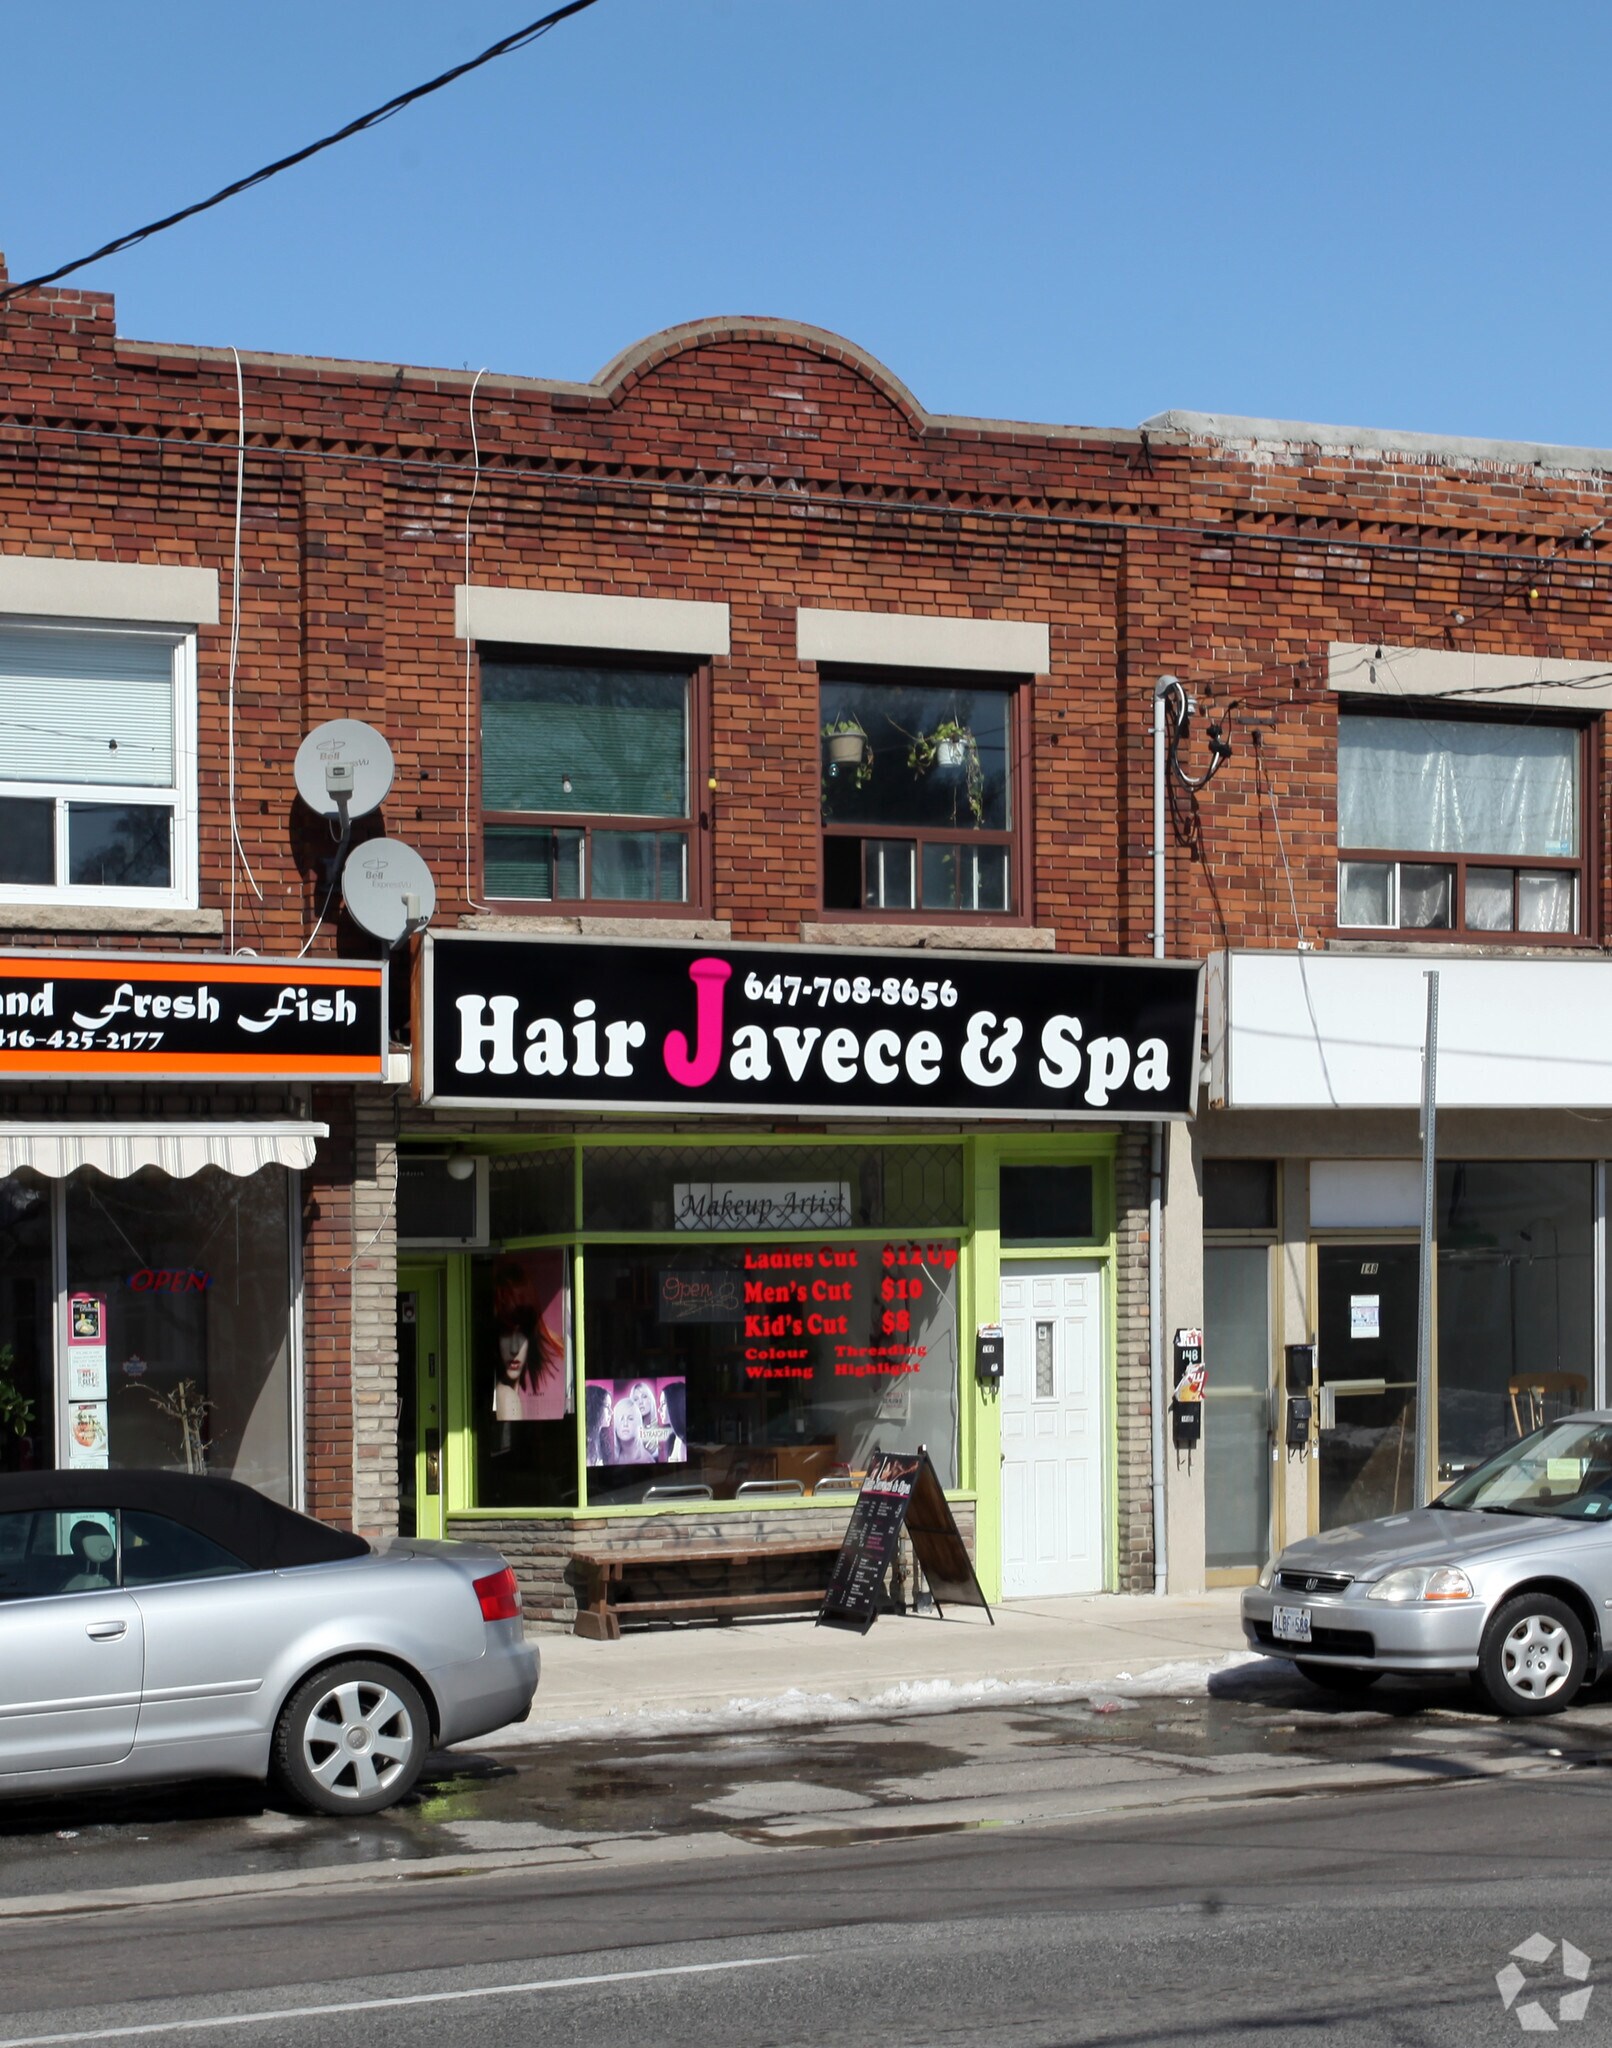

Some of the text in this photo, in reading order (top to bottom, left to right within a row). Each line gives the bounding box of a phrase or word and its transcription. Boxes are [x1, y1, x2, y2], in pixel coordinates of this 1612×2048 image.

[319, 751, 340, 761] Bell
[365, 871, 384, 880] Bell
[743, 971, 958, 1011] 647-708-8656
[72, 983, 220, 1030] Fresh
[237, 987, 357, 1033] Fish
[455, 958, 1171, 1107] Hair Javece & Spa
[681, 1189, 846, 1224] Makeup Artist
[744, 1243, 959, 1271] Ladies Cut $12 Up
[130, 1268, 209, 1293] OPEN
[661, 1277, 713, 1302] Open
[744, 1275, 924, 1304] Men's Cut $10
[744, 1308, 912, 1338] Kid's Cut $8
[744, 1343, 927, 1361] Colour Threading
[1182, 1348, 1199, 1361] 148
[745, 1361, 921, 1380] Waxing Highlight
